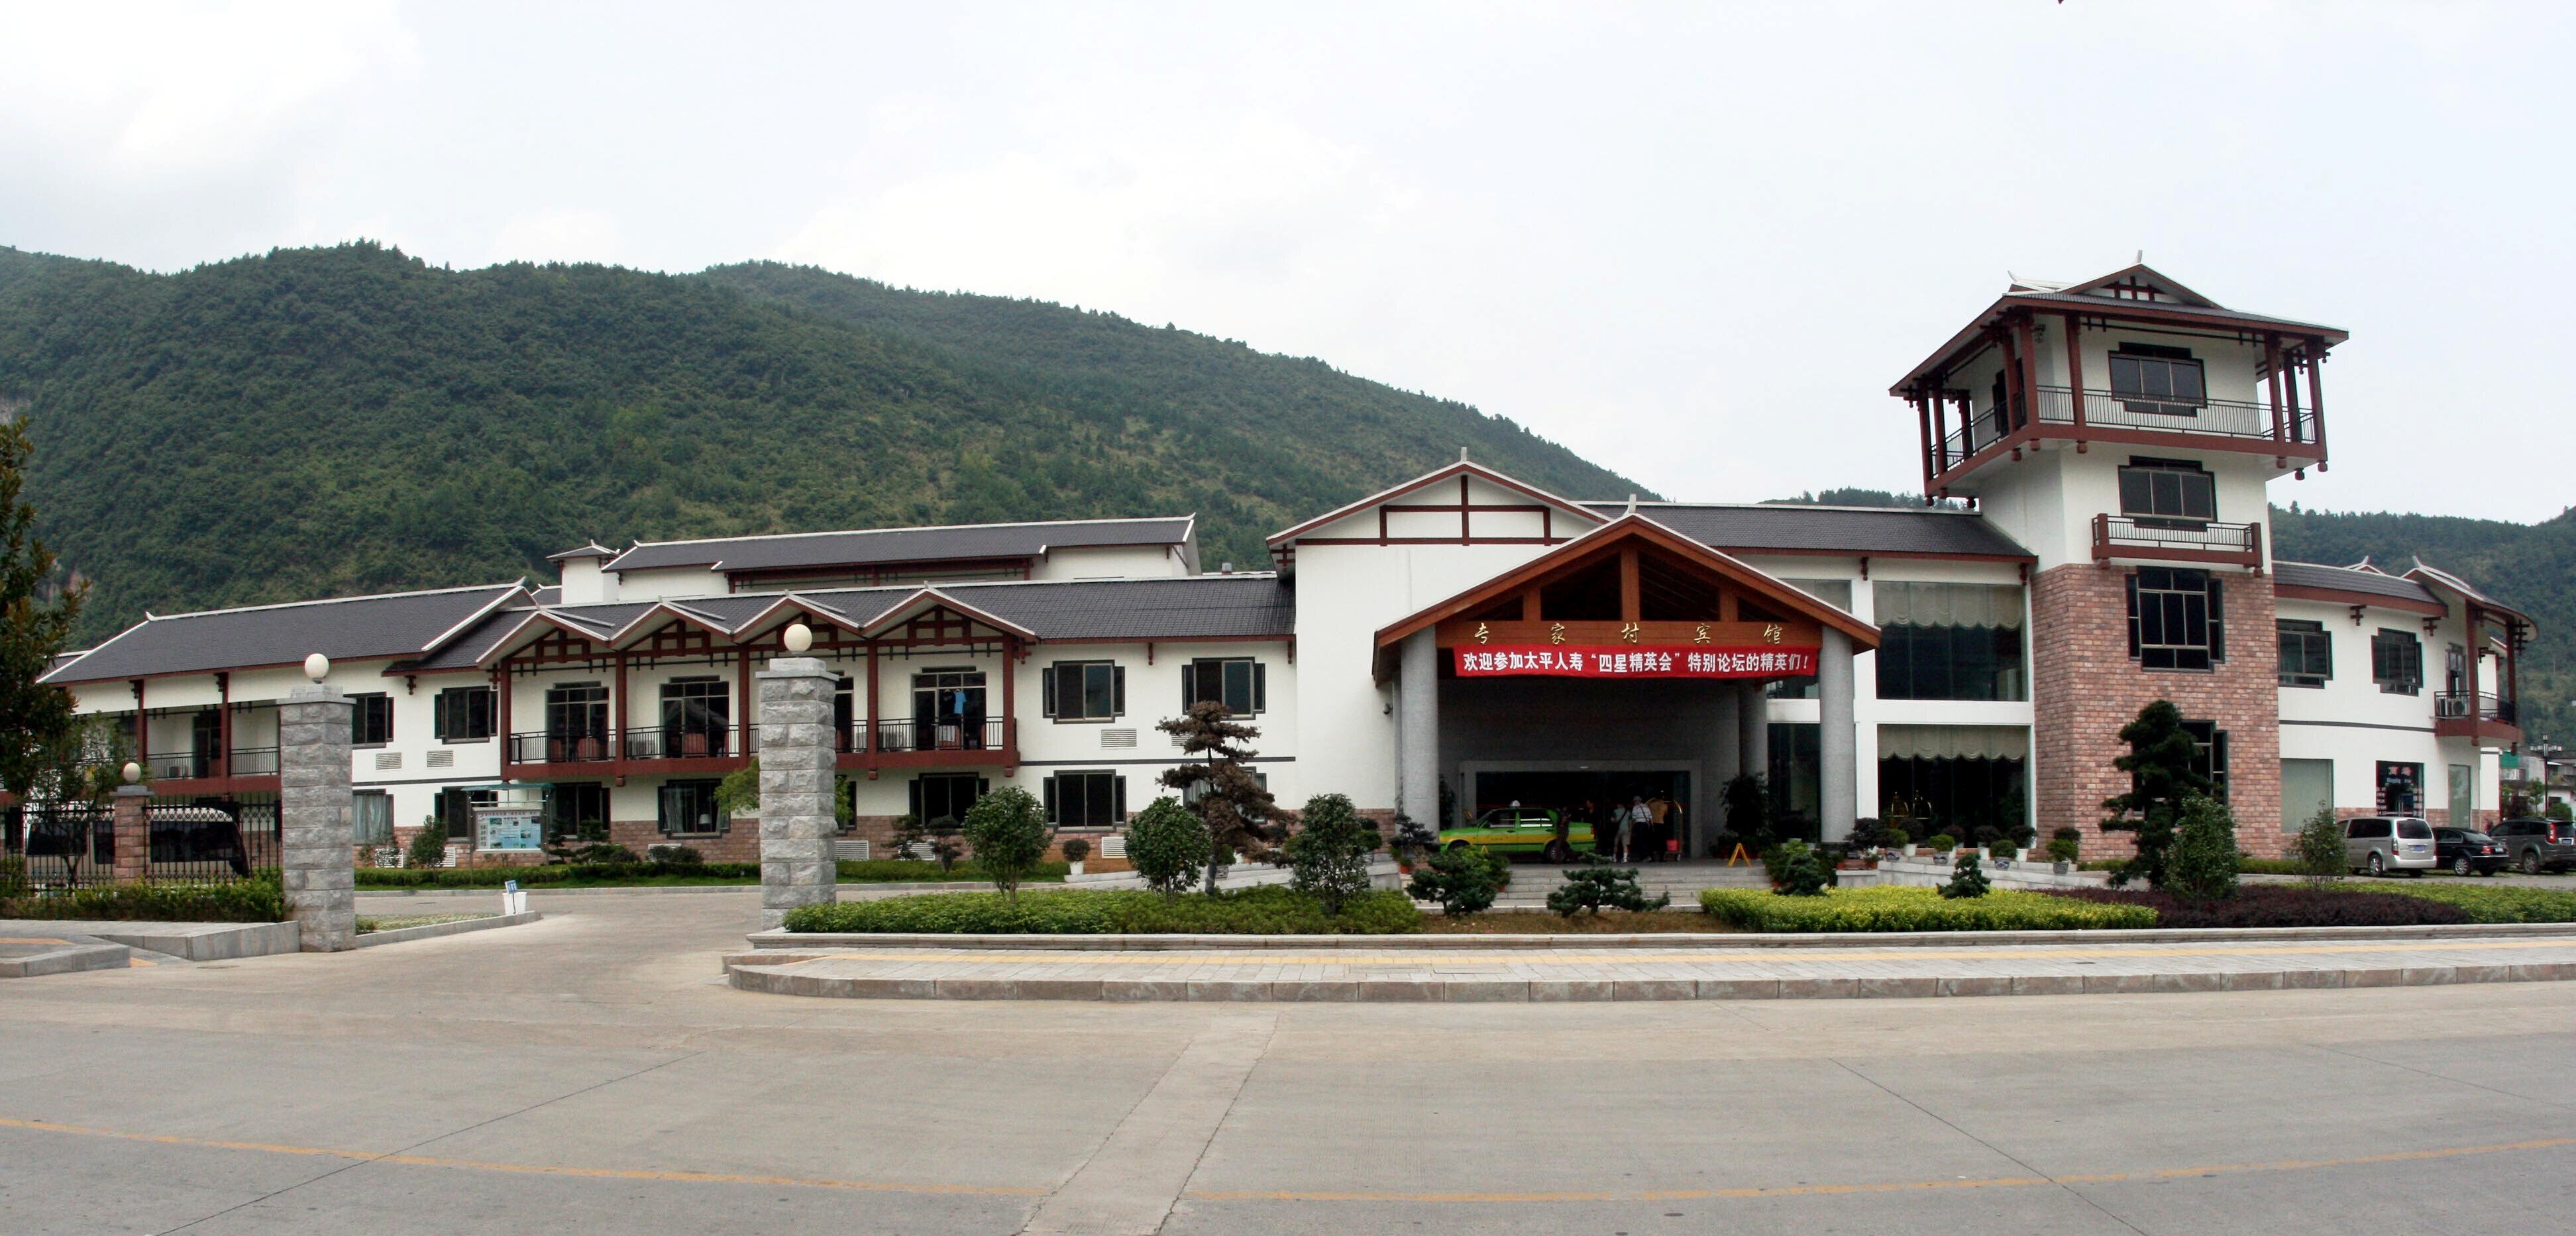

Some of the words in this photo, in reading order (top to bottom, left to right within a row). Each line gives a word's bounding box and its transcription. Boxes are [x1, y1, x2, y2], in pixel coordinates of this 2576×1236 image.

[1474, 622, 1783, 645] 专家村宾馆
